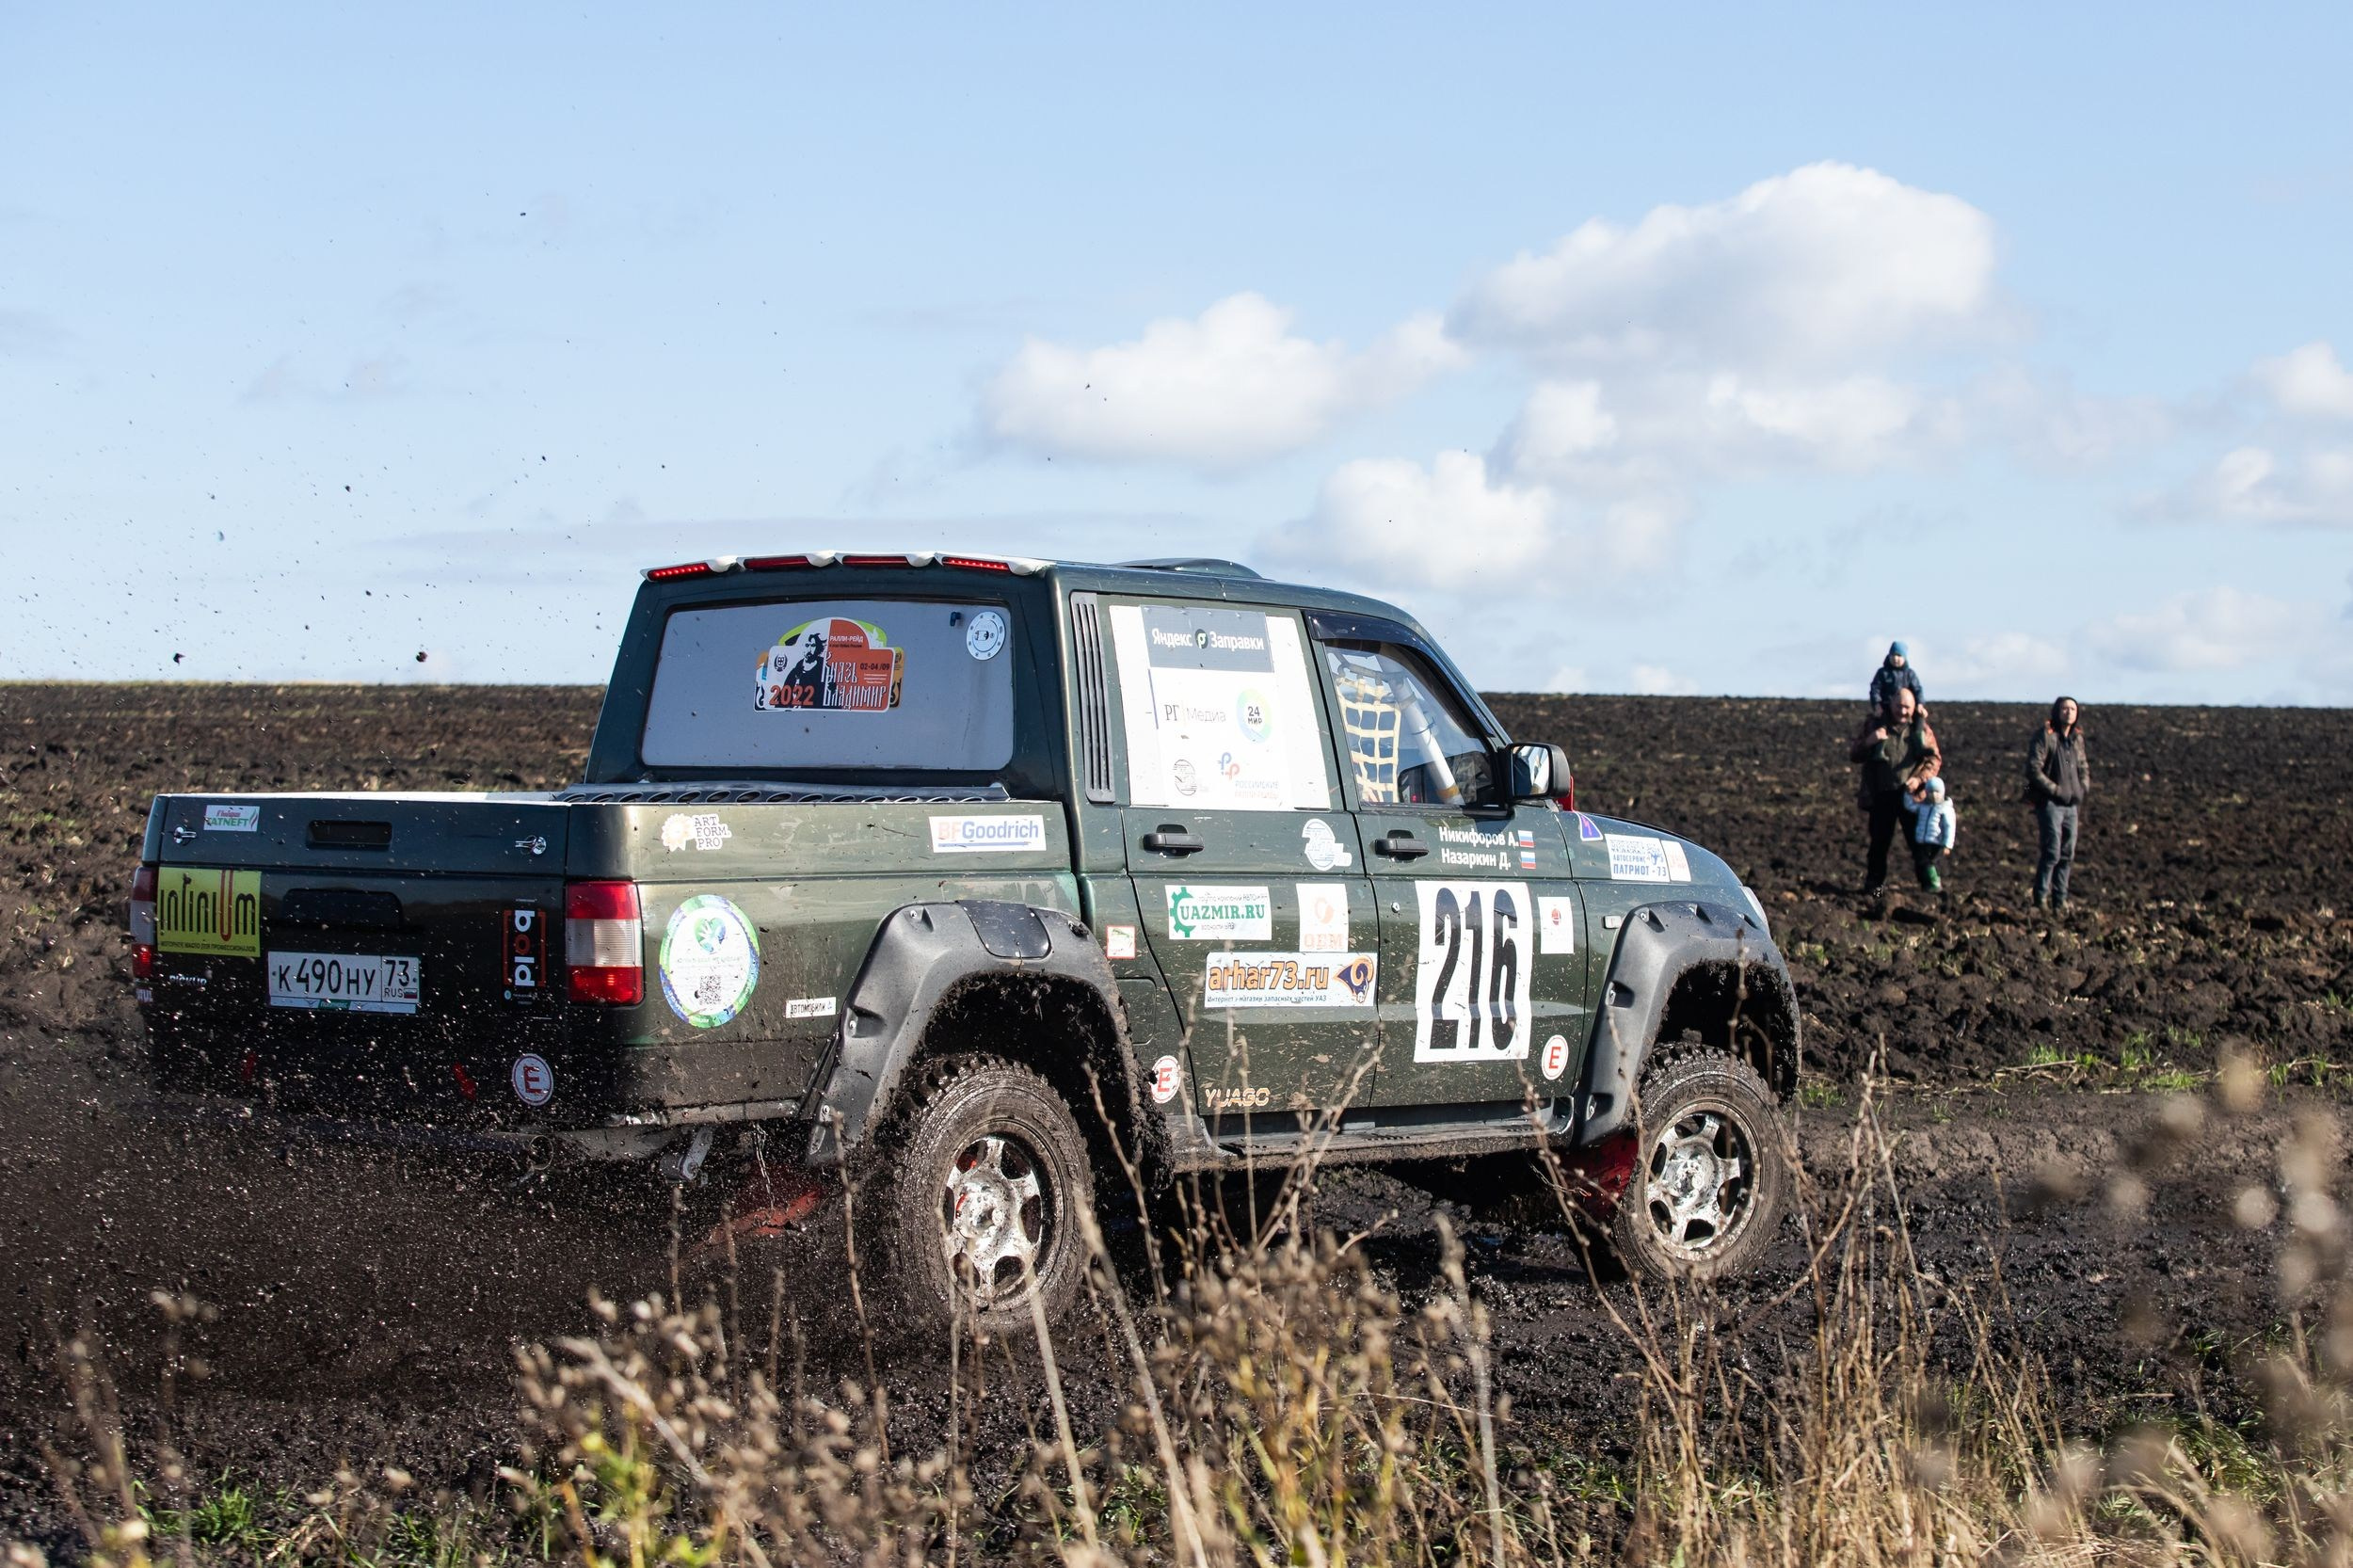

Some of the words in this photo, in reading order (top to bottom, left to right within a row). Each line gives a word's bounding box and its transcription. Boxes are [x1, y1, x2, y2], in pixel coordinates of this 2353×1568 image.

[829, 635, 864, 644] РАЛЛИ-РЕЙД
[1151, 628, 1193, 648] Яндекс
[1209, 631, 1264, 651] Заправки
[769, 684, 815, 706] 2022
[1164, 704, 1179, 721] РГ
[1186, 707, 1226, 723] Медиа
[1247, 706, 1260, 716] 24
[695, 816, 716, 827] ART
[938, 820, 1039, 840] BFGoodrich
[698, 837, 720, 848] PRO
[1438, 826, 1506, 848] Никифоров
[1508, 831, 1519, 847] А.
[1441, 848, 1497, 869] Назаркин
[1498, 851, 1512, 871] Д.
[1613, 864, 1649, 876] ПАТРИОТ
[1657, 866, 1667, 877] 73
[1180, 904, 1265, 920] UAZMIR.RU
[279, 958, 376, 995] К490НУ
[384, 960, 409, 986] 73
[1209, 960, 1329, 991] arhar73.ru
[1430, 887, 1518, 1051] 216
[384, 988, 404, 998] RUS
[1548, 1046, 1561, 1069] E
[523, 1065, 543, 1095] E
[1158, 1067, 1172, 1092] E
